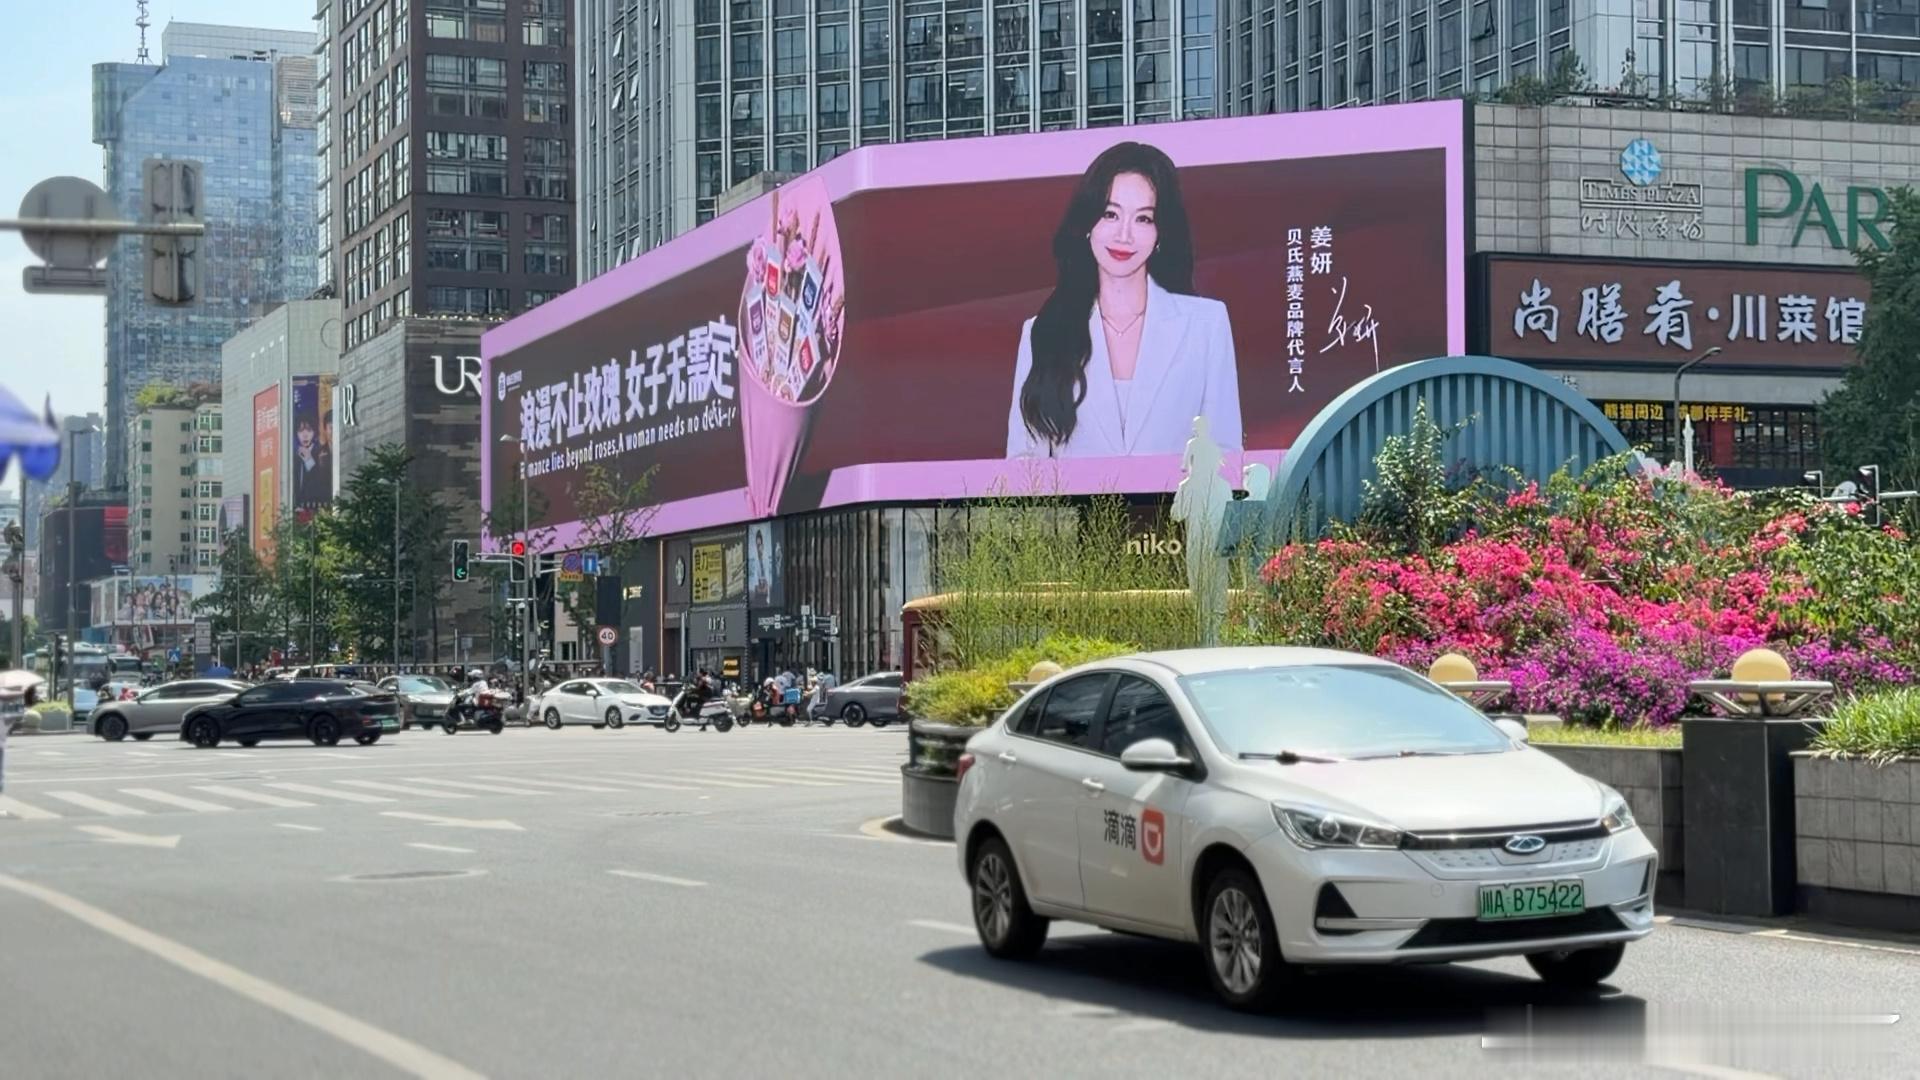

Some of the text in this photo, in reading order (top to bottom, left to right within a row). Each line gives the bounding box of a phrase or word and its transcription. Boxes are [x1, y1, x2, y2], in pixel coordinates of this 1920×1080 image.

[1584, 181, 1699, 204] TIMES PLAZA
[1310, 226, 1333, 274] 姜妍
[1286, 228, 1305, 393] 贝氏燕麦品牌代言人
[430, 355, 481, 397] UR
[342, 383, 355, 426] UR
[551, 450, 565, 472] lies
[566, 440, 593, 470] beyond
[625, 426, 655, 450] woman
[658, 415, 685, 442] needs
[687, 415, 699, 433] no
[601, 631, 614, 641] 40
[1103, 809, 1137, 851] 滴滴
